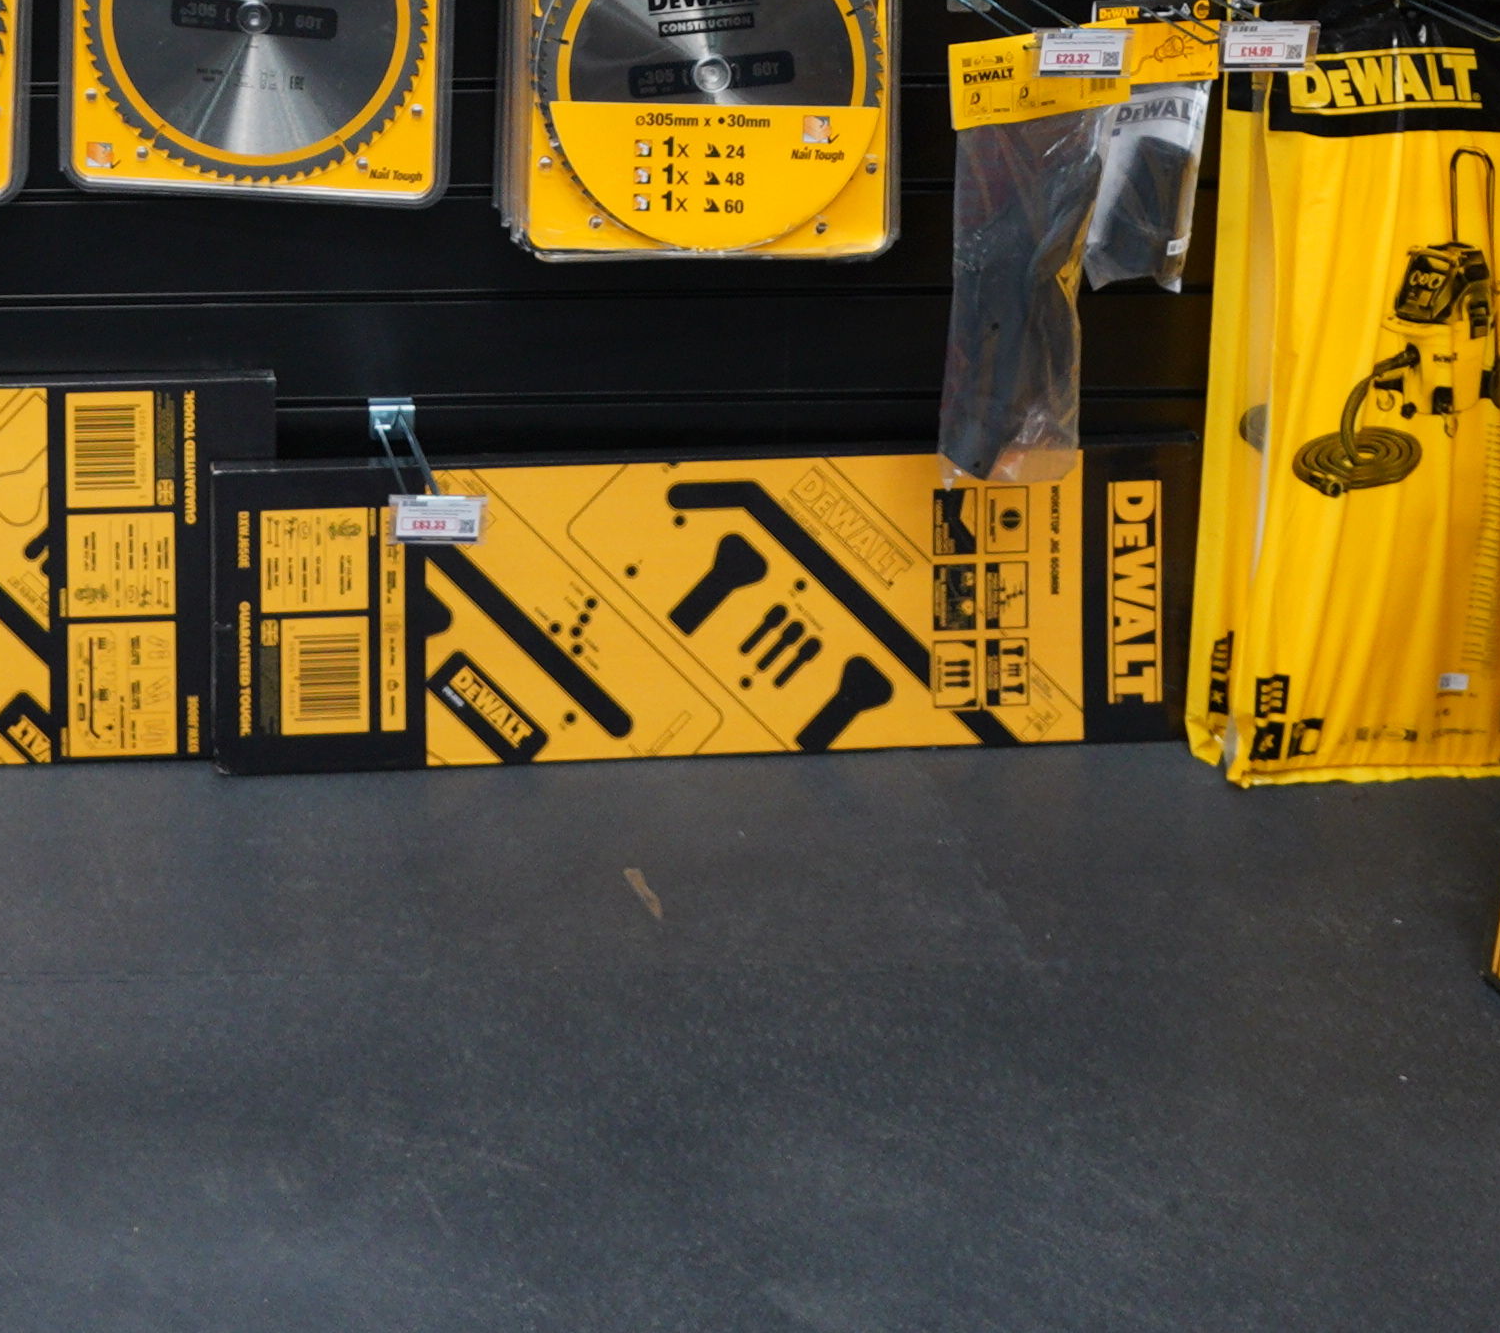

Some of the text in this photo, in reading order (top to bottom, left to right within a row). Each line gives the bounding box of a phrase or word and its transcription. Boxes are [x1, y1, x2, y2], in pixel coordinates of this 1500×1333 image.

[1290, 55, 1478, 109] DEWALT
[1113, 482, 1158, 702] DEWALT
[450, 666, 533, 748] DEWALT
